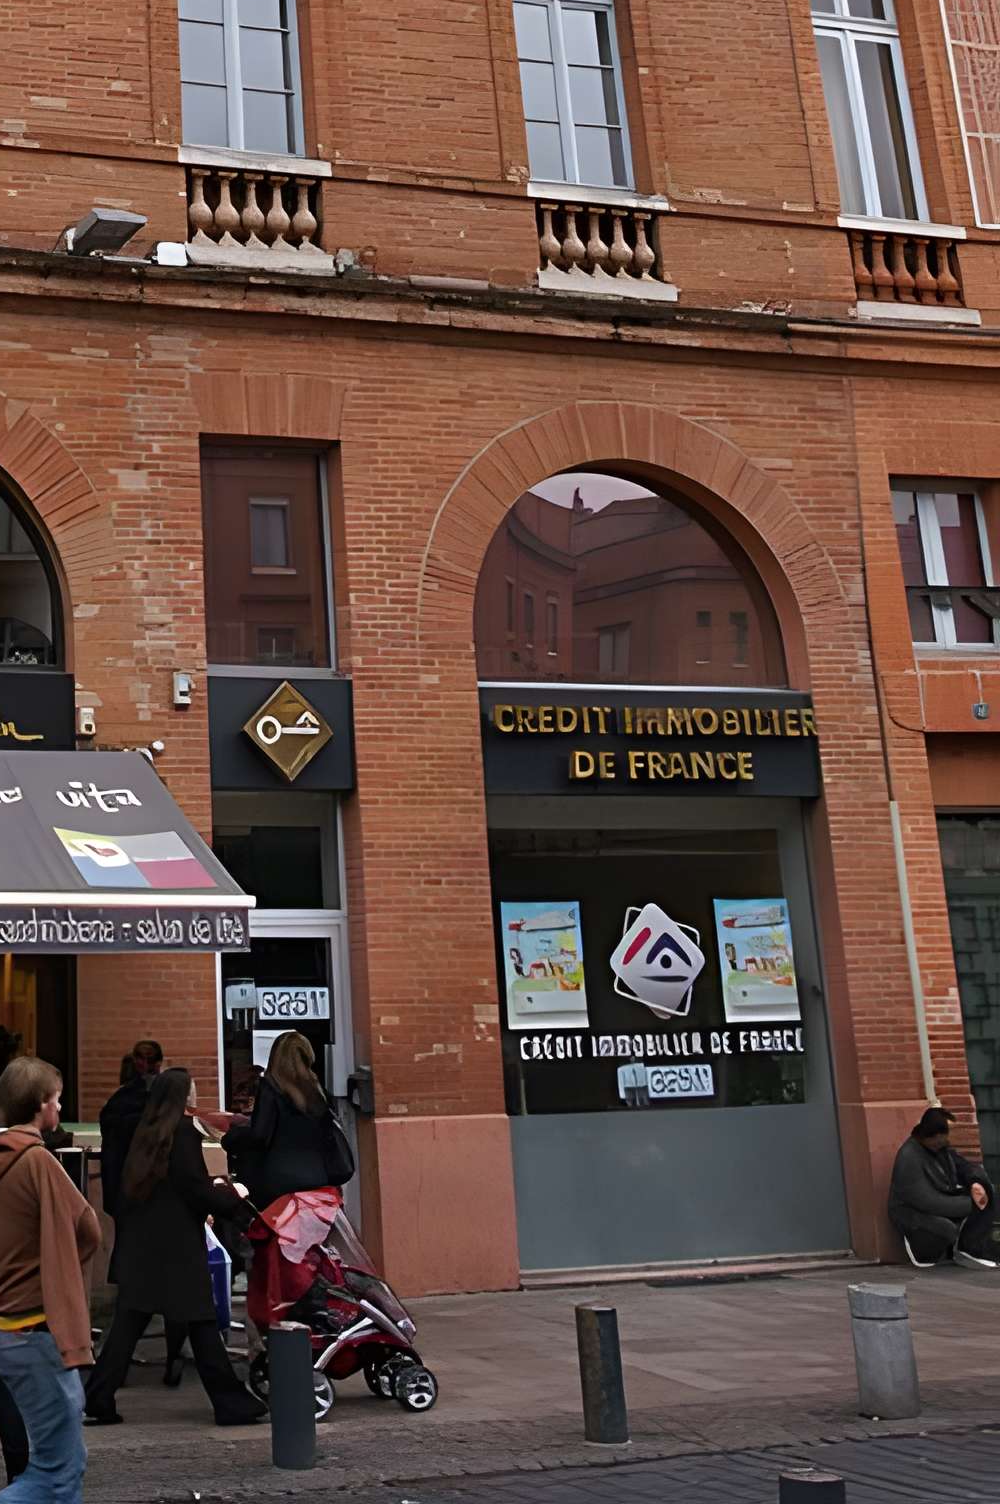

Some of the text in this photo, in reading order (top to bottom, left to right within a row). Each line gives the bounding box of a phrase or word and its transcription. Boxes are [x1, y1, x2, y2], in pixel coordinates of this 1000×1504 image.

[623, 706, 818, 737] IMMOBILIER
[570, 751, 754, 780] DE FRANCE
[56, 781, 142, 812] vita
[591, 1031, 704, 1057] IMMOBILIER
[710, 1031, 731, 1054] DE
